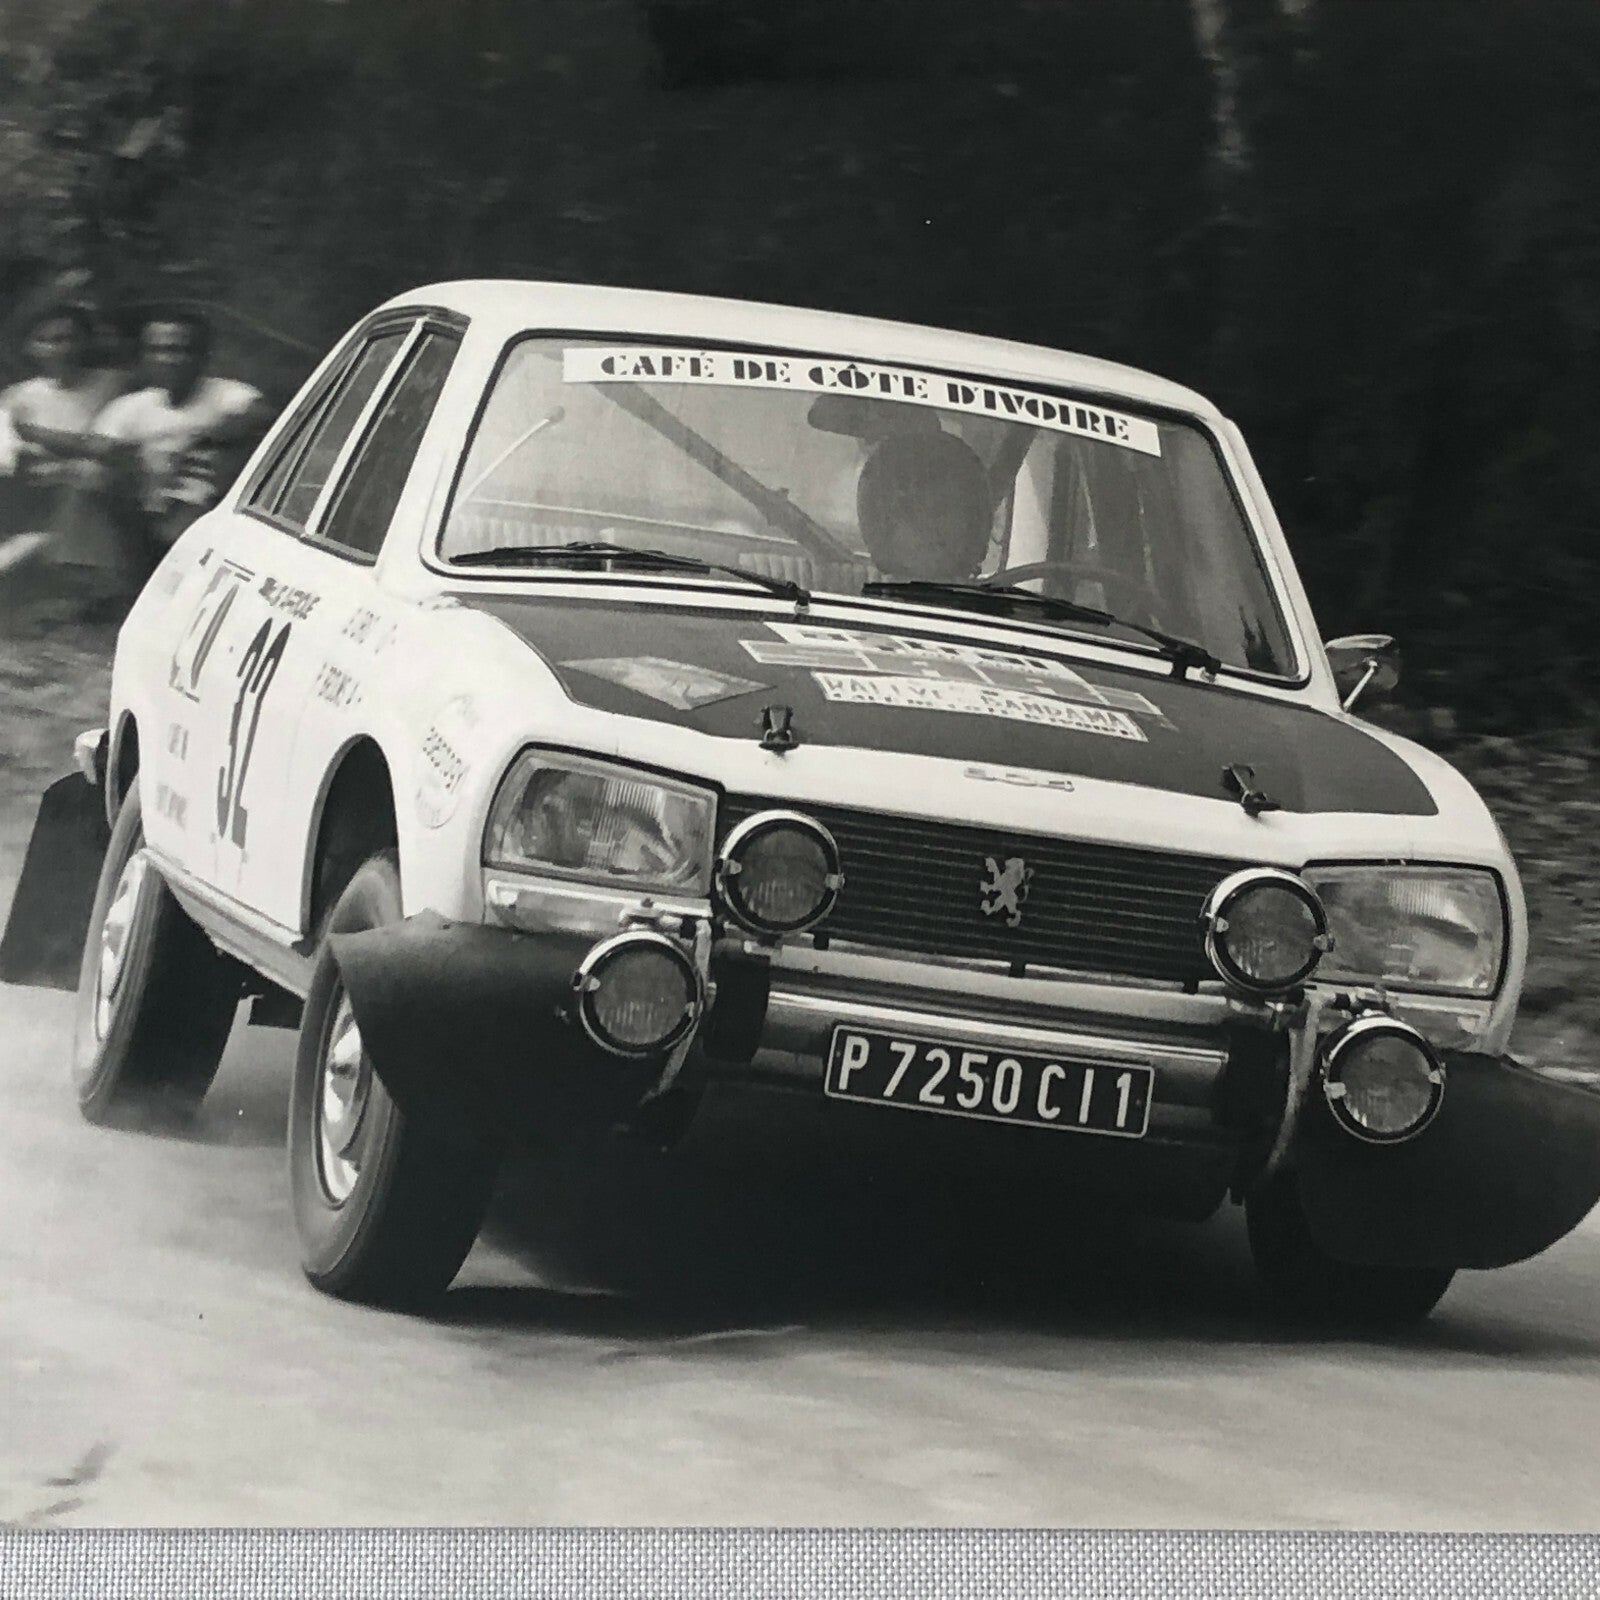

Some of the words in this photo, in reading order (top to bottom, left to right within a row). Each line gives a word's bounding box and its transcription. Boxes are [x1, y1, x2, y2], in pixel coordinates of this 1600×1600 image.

[600, 351, 715, 377] CAFÉ
[733, 359, 791, 383] DE
[807, 363, 929, 399] CÔTE
[946, 382, 1130, 441] D'IVOIRE
[837, 1035, 870, 1091] P
[882, 1040, 1023, 1115] 7250
